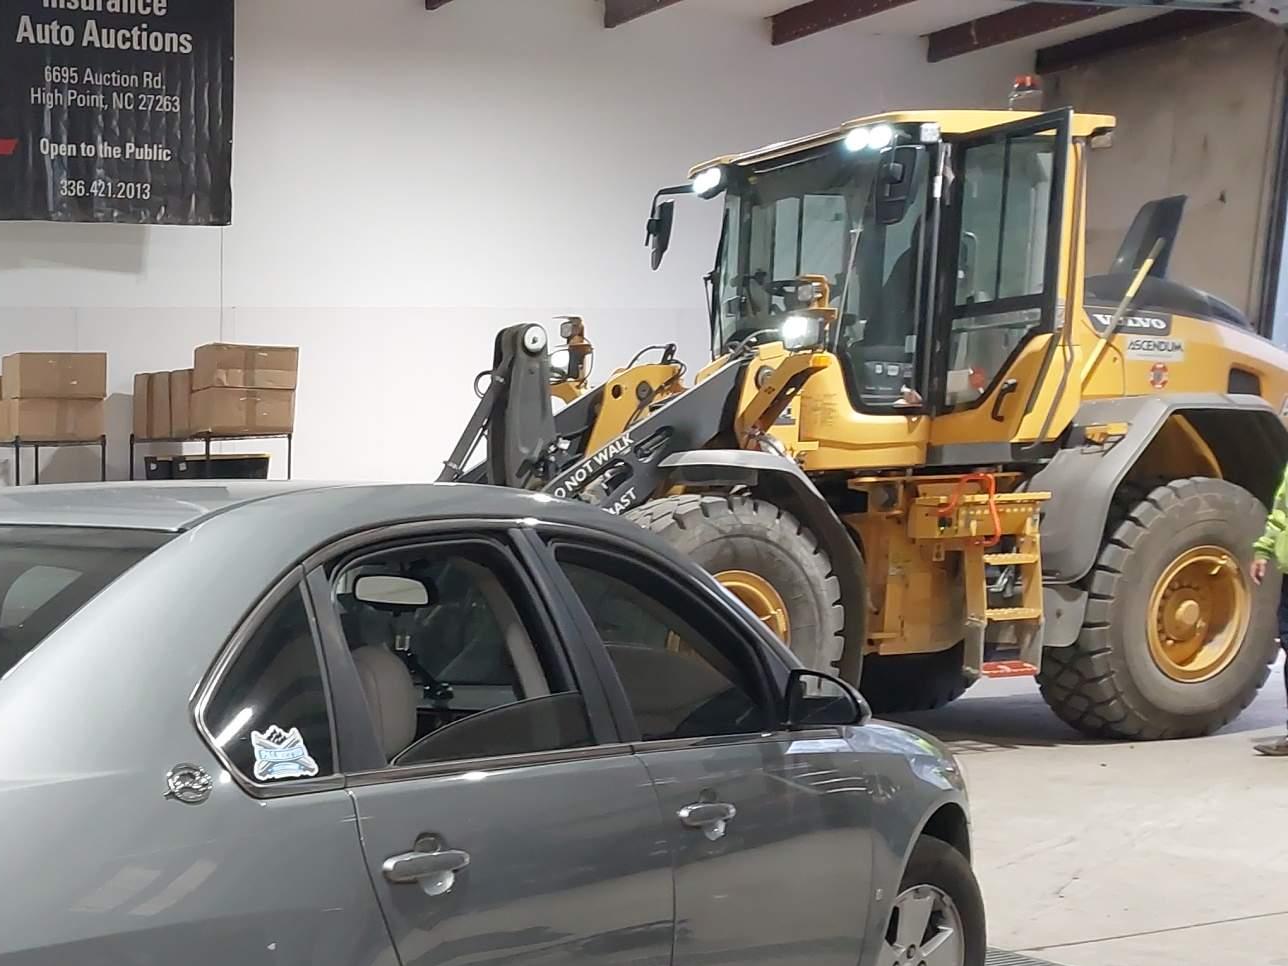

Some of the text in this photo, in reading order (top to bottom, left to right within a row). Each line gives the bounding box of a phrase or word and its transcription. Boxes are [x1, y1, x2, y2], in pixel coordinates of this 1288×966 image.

[43, 0, 167, 16] surance
[16, 15, 193, 53] Auto Auctions
[44, 65, 78, 84] 6695
[83, 68, 139, 87] Auction
[30, 87, 181, 113] High Point, NC 27263
[40, 138, 172, 162] Open to the Public
[60, 180, 151, 200] 336.421.2013
[1093, 314, 1167, 329] VLVO
[1127, 339, 1184, 352] ASCENDUM
[564, 460, 594, 491] NOT
[593, 432, 634, 465] WALK
